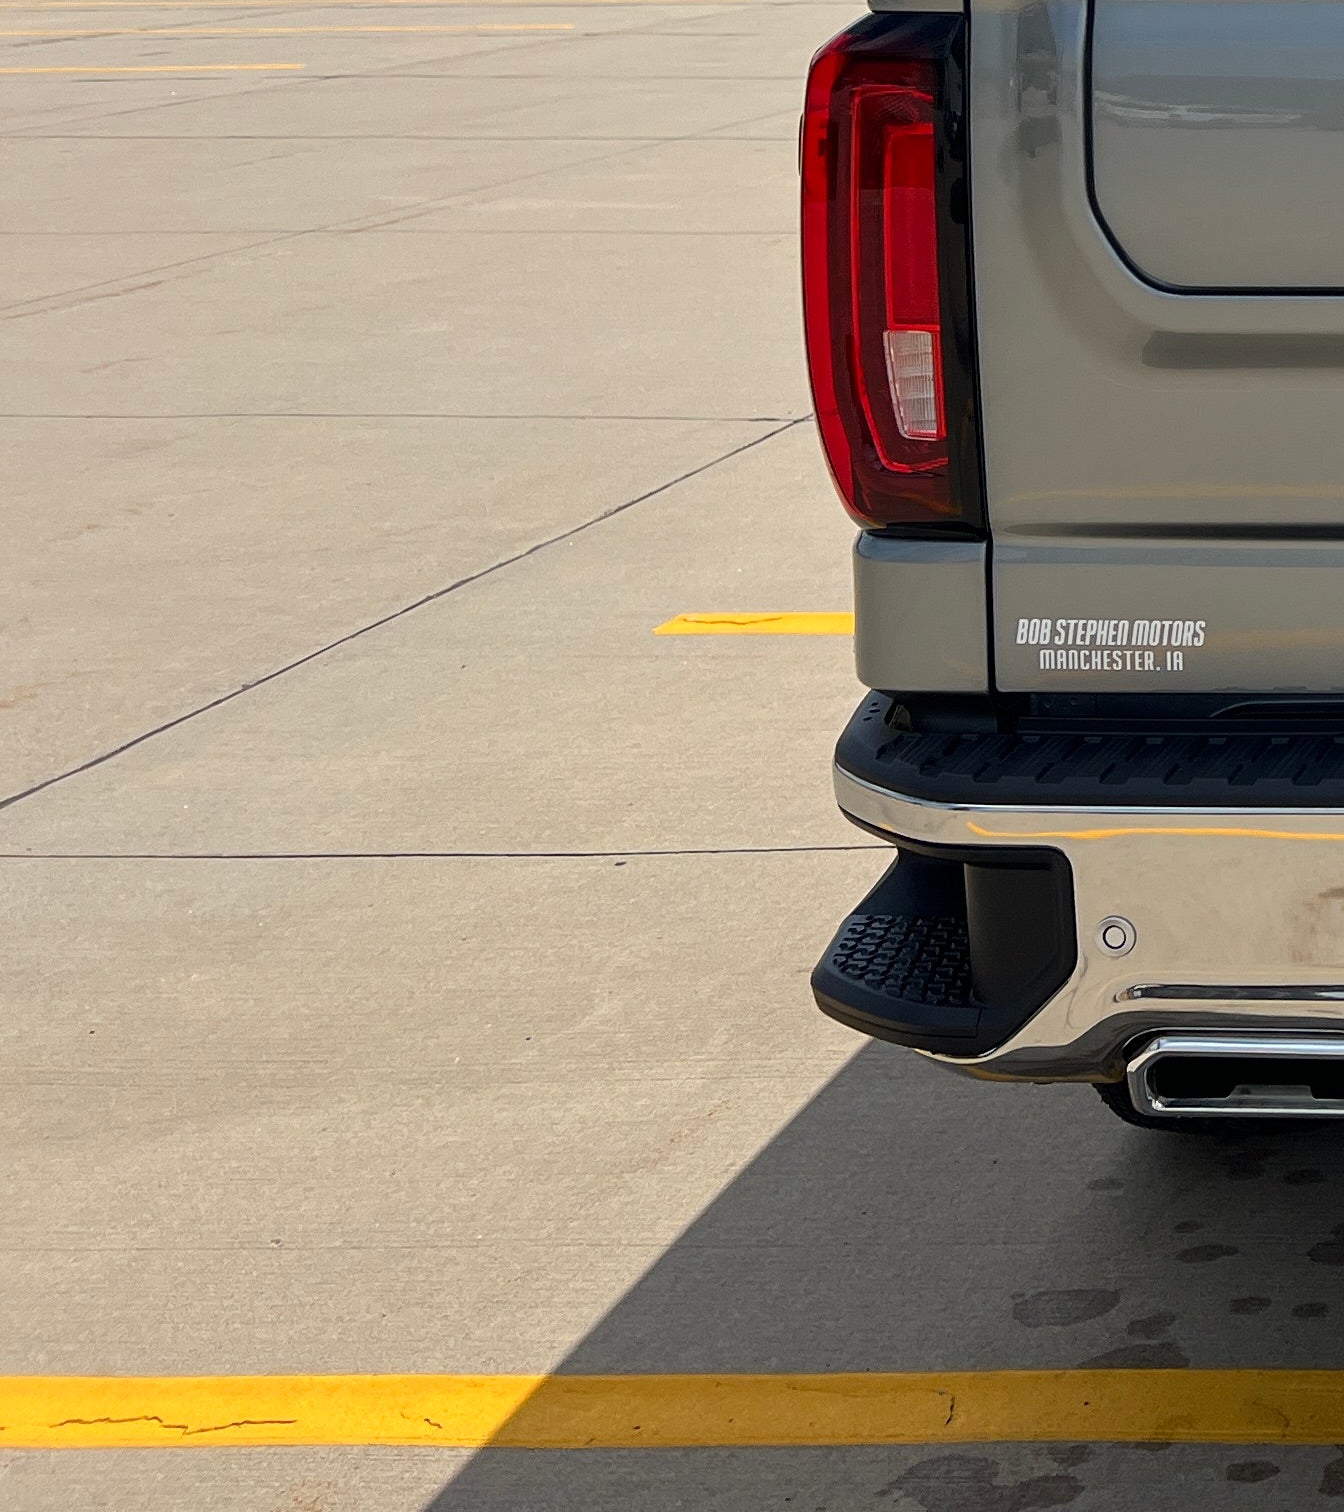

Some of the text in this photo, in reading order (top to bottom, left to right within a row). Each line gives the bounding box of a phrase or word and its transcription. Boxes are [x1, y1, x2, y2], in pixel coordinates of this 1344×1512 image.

[1016, 618, 1206, 648] BOB STEPHEN MOTORS
[1166, 650, 1184, 672] IA
